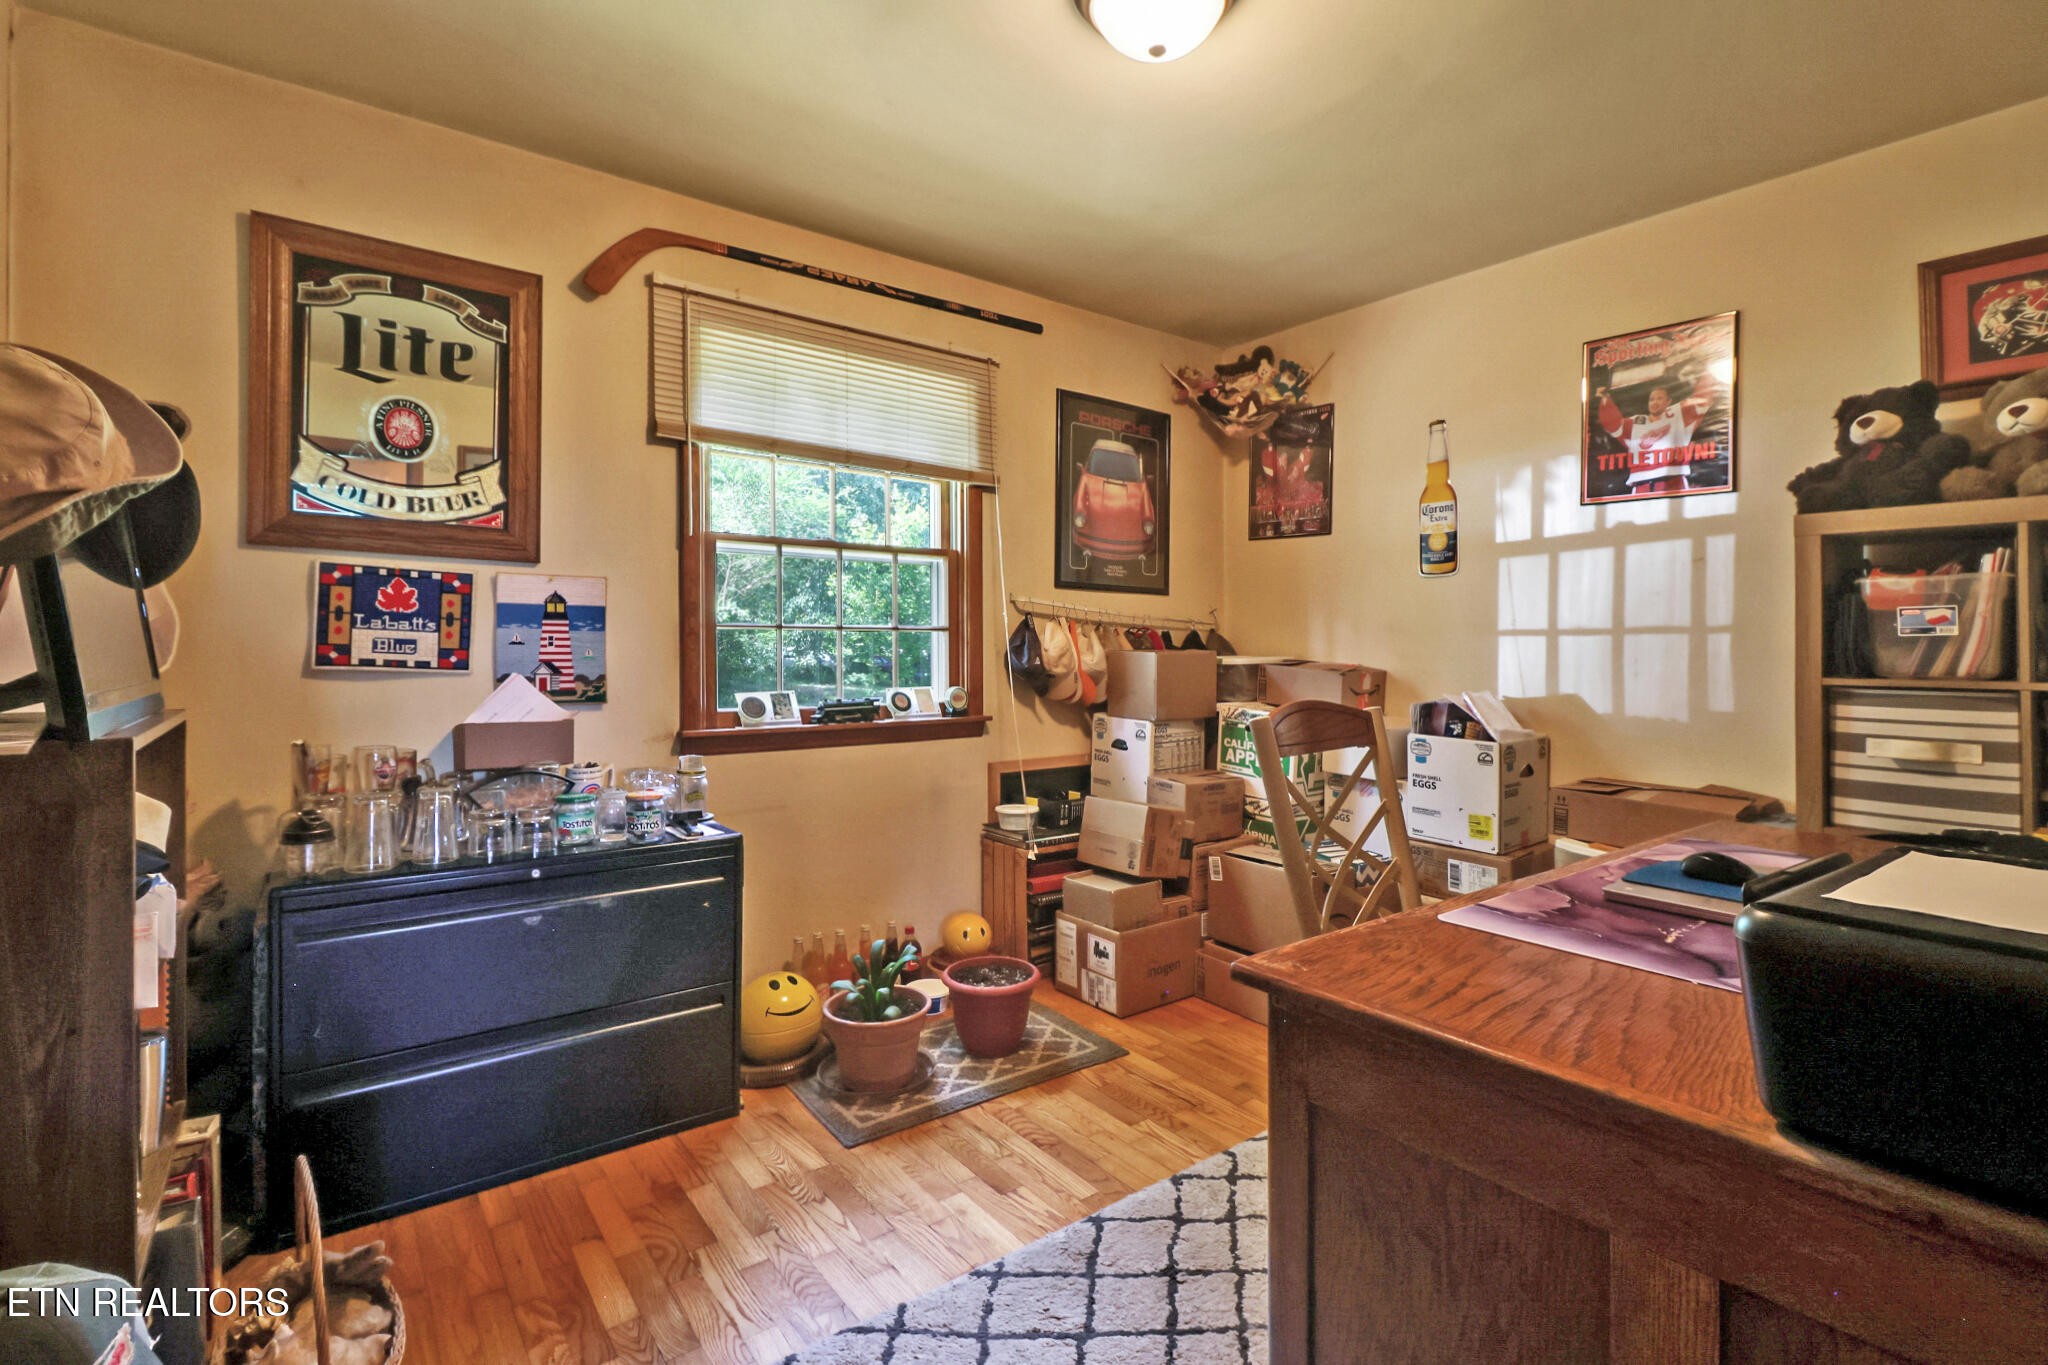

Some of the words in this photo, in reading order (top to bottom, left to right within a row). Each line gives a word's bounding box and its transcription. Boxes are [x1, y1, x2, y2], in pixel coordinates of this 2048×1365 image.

[333, 311, 474, 384] Lite
[1597, 441, 1717, 472] TITLETOWN!
[318, 475, 397, 509] COLD
[406, 490, 485, 514] BEER
[1421, 503, 1455, 517] Corona
[353, 613, 437, 632] Labatt's
[374, 638, 416, 654] Blue
[1223, 737, 1256, 751] CALIF
[1412, 778, 1437, 790] EGGS
